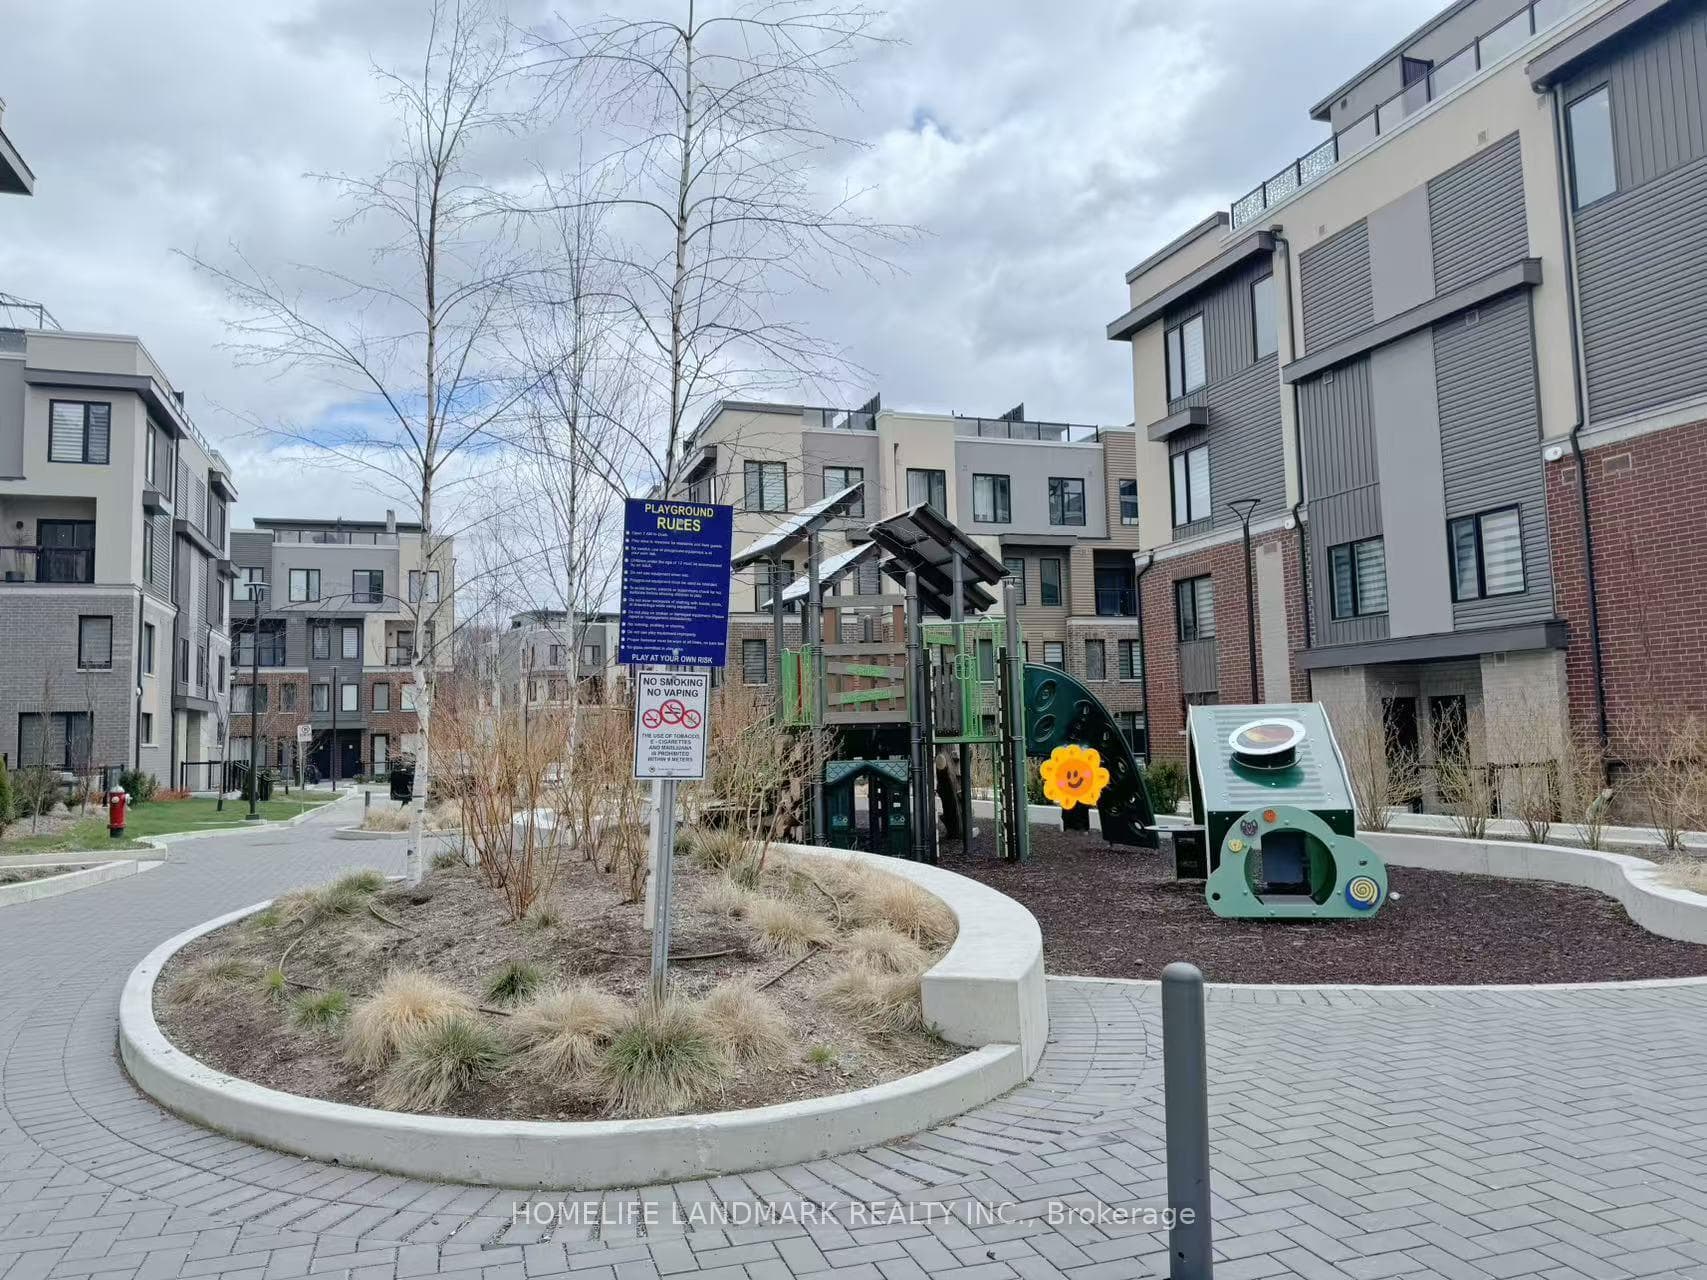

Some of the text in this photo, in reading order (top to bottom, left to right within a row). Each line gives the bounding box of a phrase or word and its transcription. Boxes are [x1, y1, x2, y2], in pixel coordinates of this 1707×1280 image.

[644, 503, 714, 518] PLAYGROUND
[656, 516, 701, 532] RULES
[631, 653, 650, 661] PLAY
[660, 655, 679, 663] YOUR
[680, 655, 697, 663] OWN
[697, 656, 713, 664] RISK
[643, 677, 703, 687] NO SMOKING
[647, 688, 699, 697] NO VAPING
